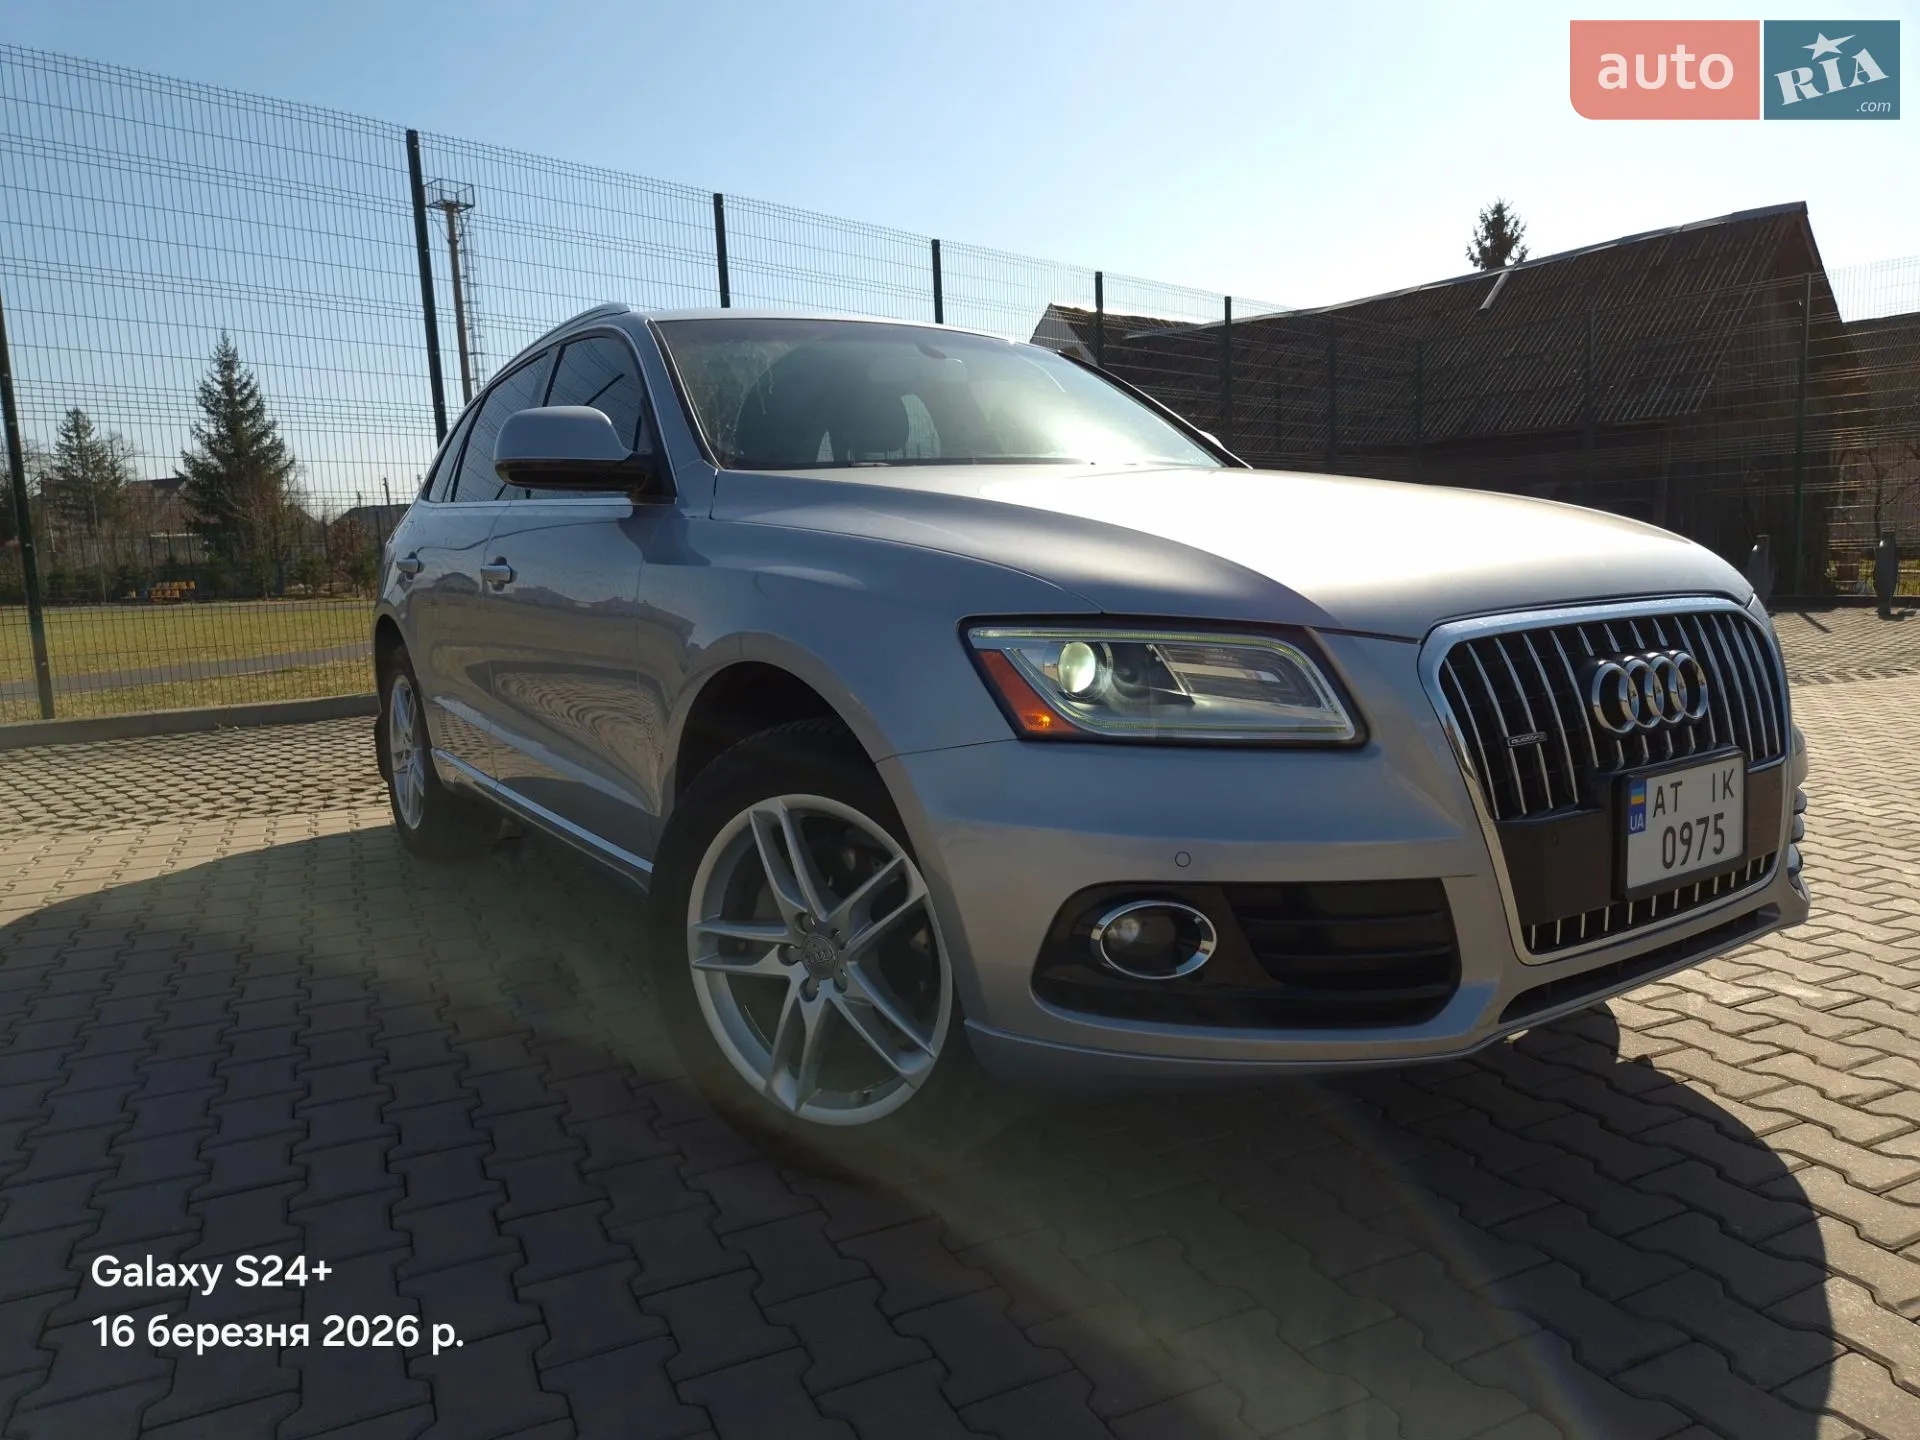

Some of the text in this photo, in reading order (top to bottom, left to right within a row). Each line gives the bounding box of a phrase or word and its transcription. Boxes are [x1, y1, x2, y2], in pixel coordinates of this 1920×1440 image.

[1653, 768, 1734, 818] AT IK
[1630, 813, 1645, 831] UA
[1662, 812, 1725, 869] 0975
